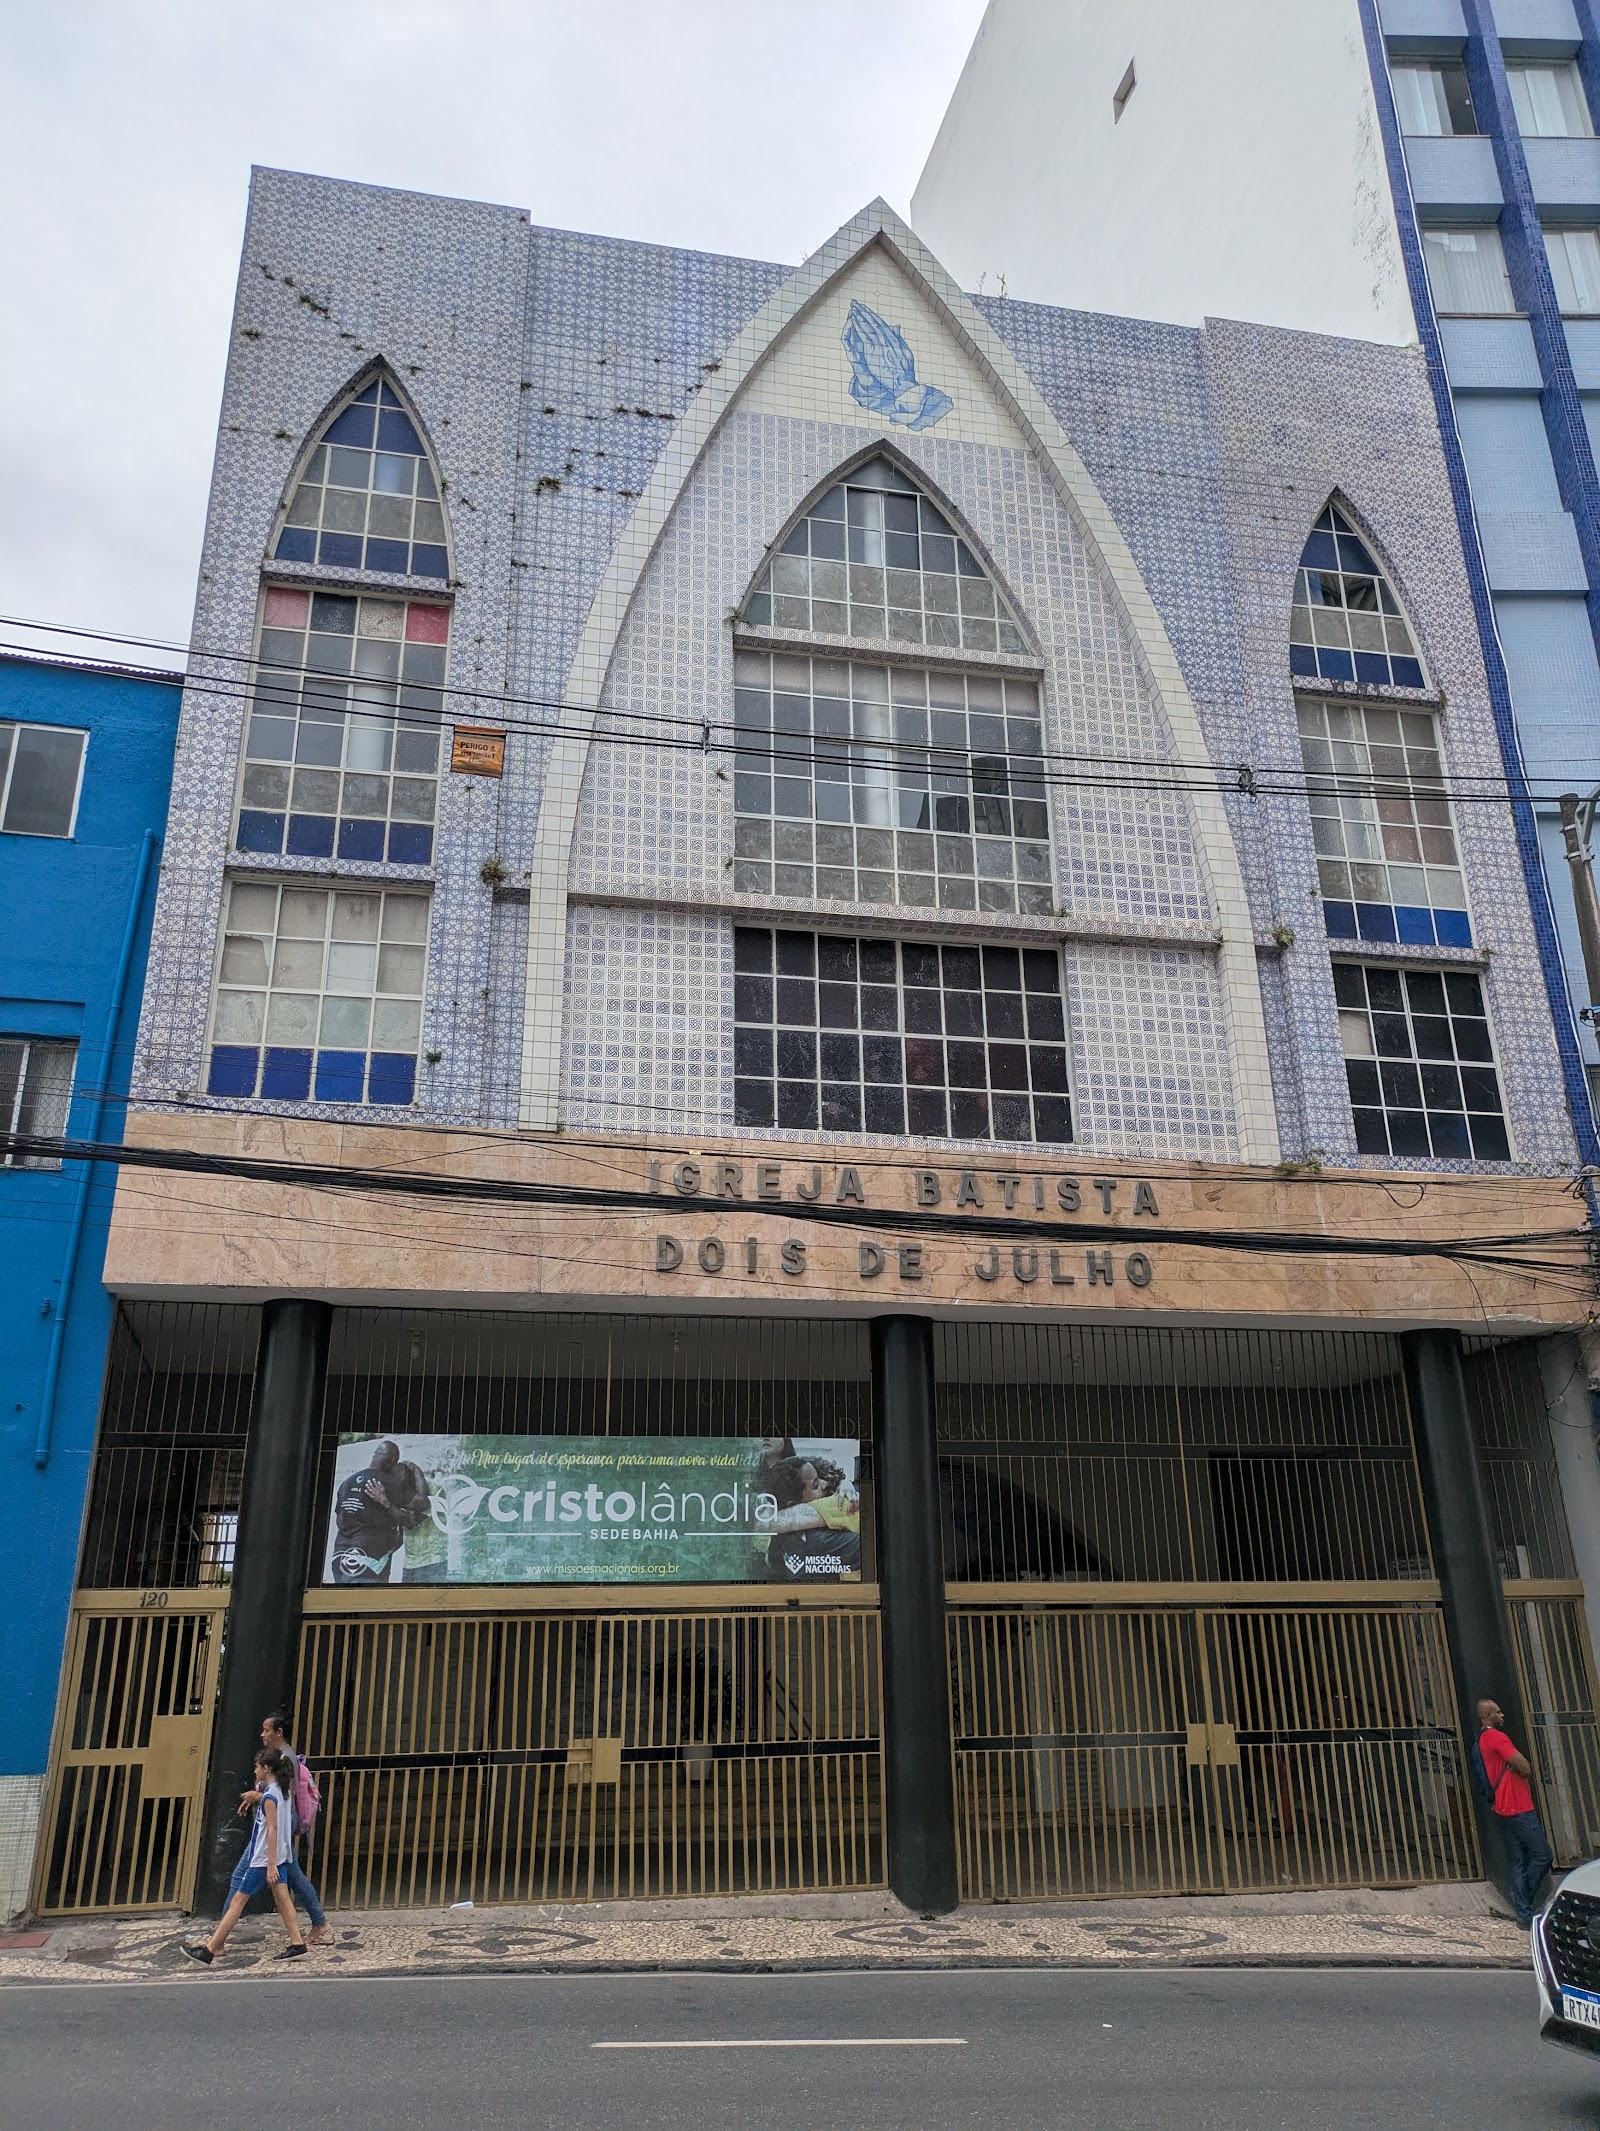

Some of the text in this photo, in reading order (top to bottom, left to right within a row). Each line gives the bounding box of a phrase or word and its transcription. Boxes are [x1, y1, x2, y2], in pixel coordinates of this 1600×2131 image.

[460, 741, 488, 751] PERIGO
[650, 1158, 1160, 1215] IGREJA BATISTA
[656, 1233, 1152, 1286] DOIS DE JULHO
[503, 1451, 535, 1472] lugar
[539, 1451, 554, 1465] de
[557, 1453, 613, 1471] esperança
[616, 1454, 646, 1472] para
[649, 1455, 674, 1466] uma
[679, 1455, 707, 1466] nova
[710, 1453, 740, 1466] vida!
[488, 1480, 779, 1523] Cristolândia
[805, 1554, 842, 1565] MISSÕES
[526, 1561, 680, 1577] www.missoesnacionais.org.br
[805, 1564, 852, 1574] NACIONAIS
[139, 1591, 169, 1609] 120
